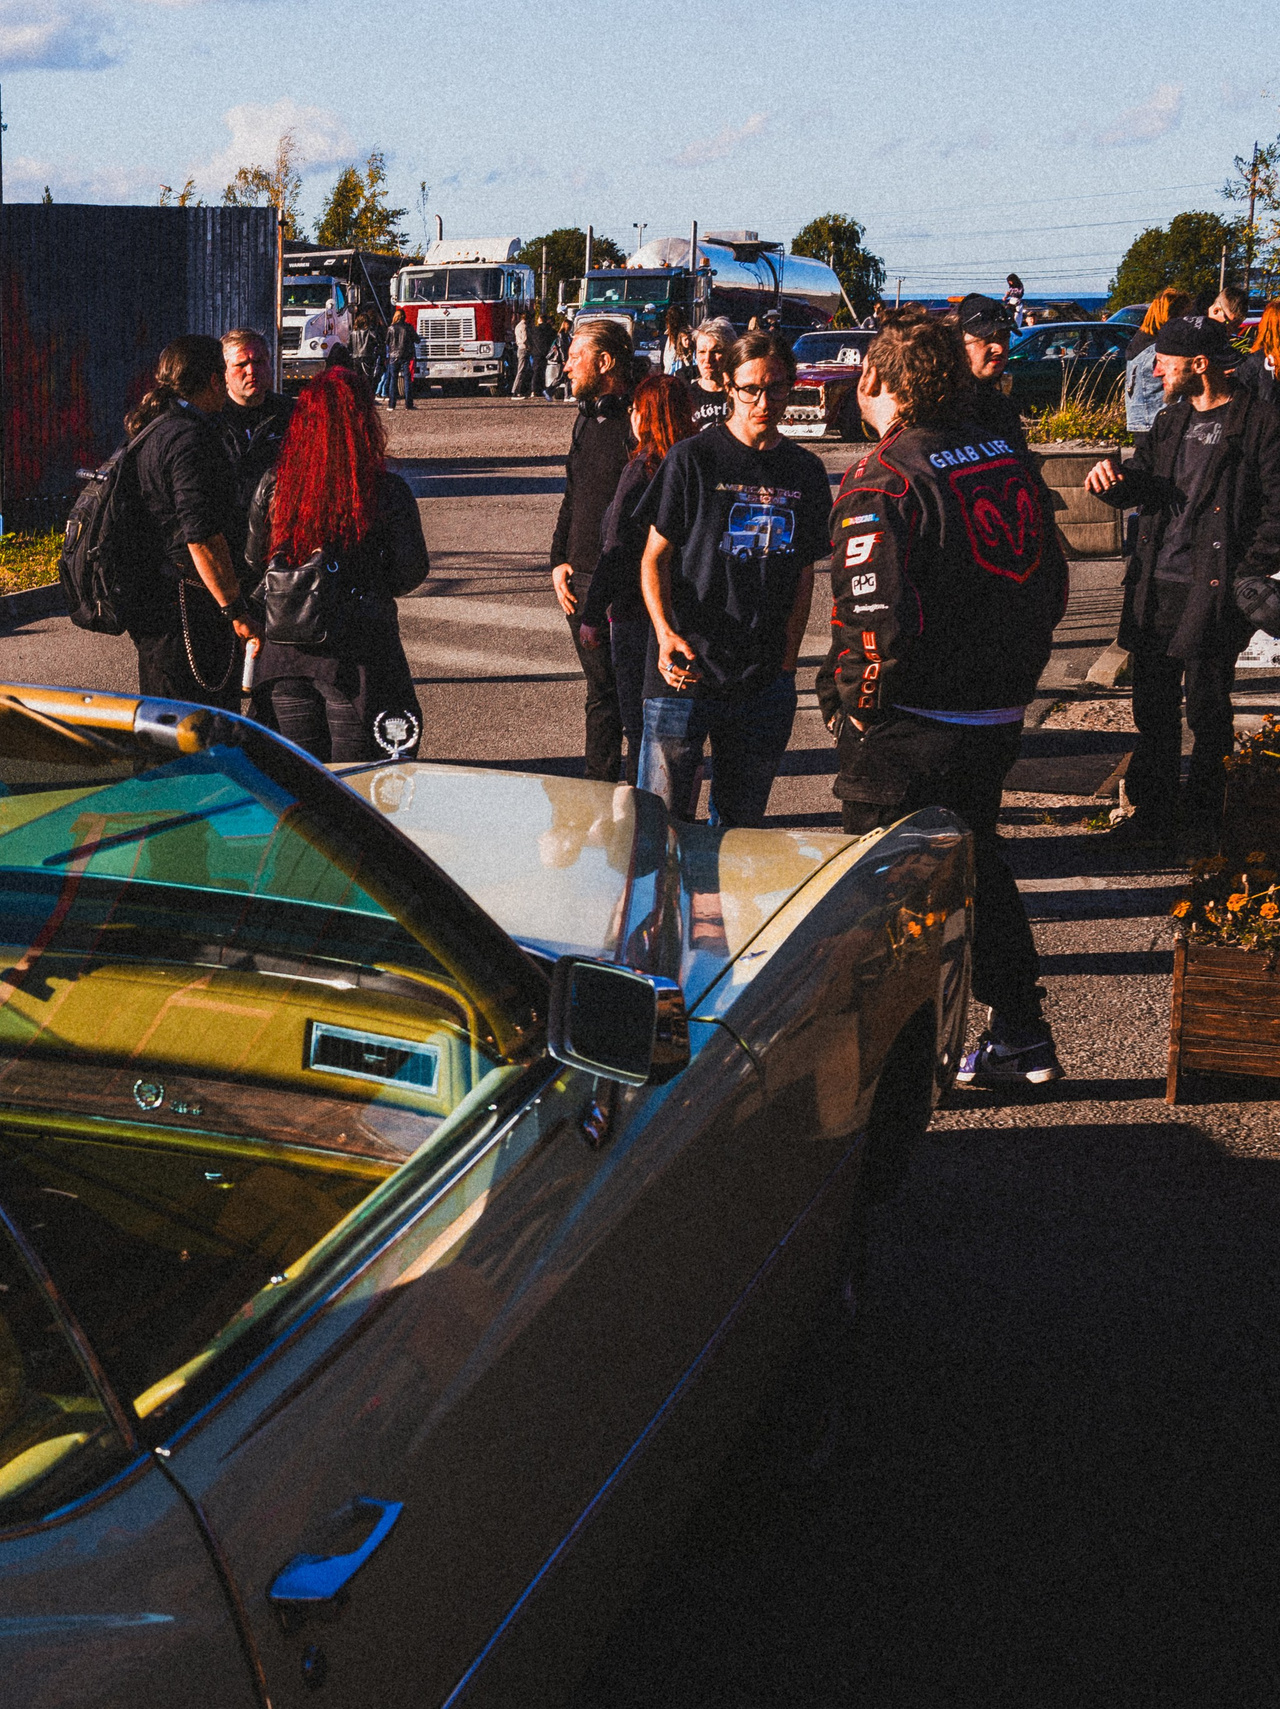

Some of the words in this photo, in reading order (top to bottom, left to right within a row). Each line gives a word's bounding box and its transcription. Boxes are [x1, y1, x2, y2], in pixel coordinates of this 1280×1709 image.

[929, 445, 981, 469] GRAB
[715, 482, 775, 495] AMERICAN
[845, 533, 878, 568] 9
[853, 573, 875, 591] PPG
